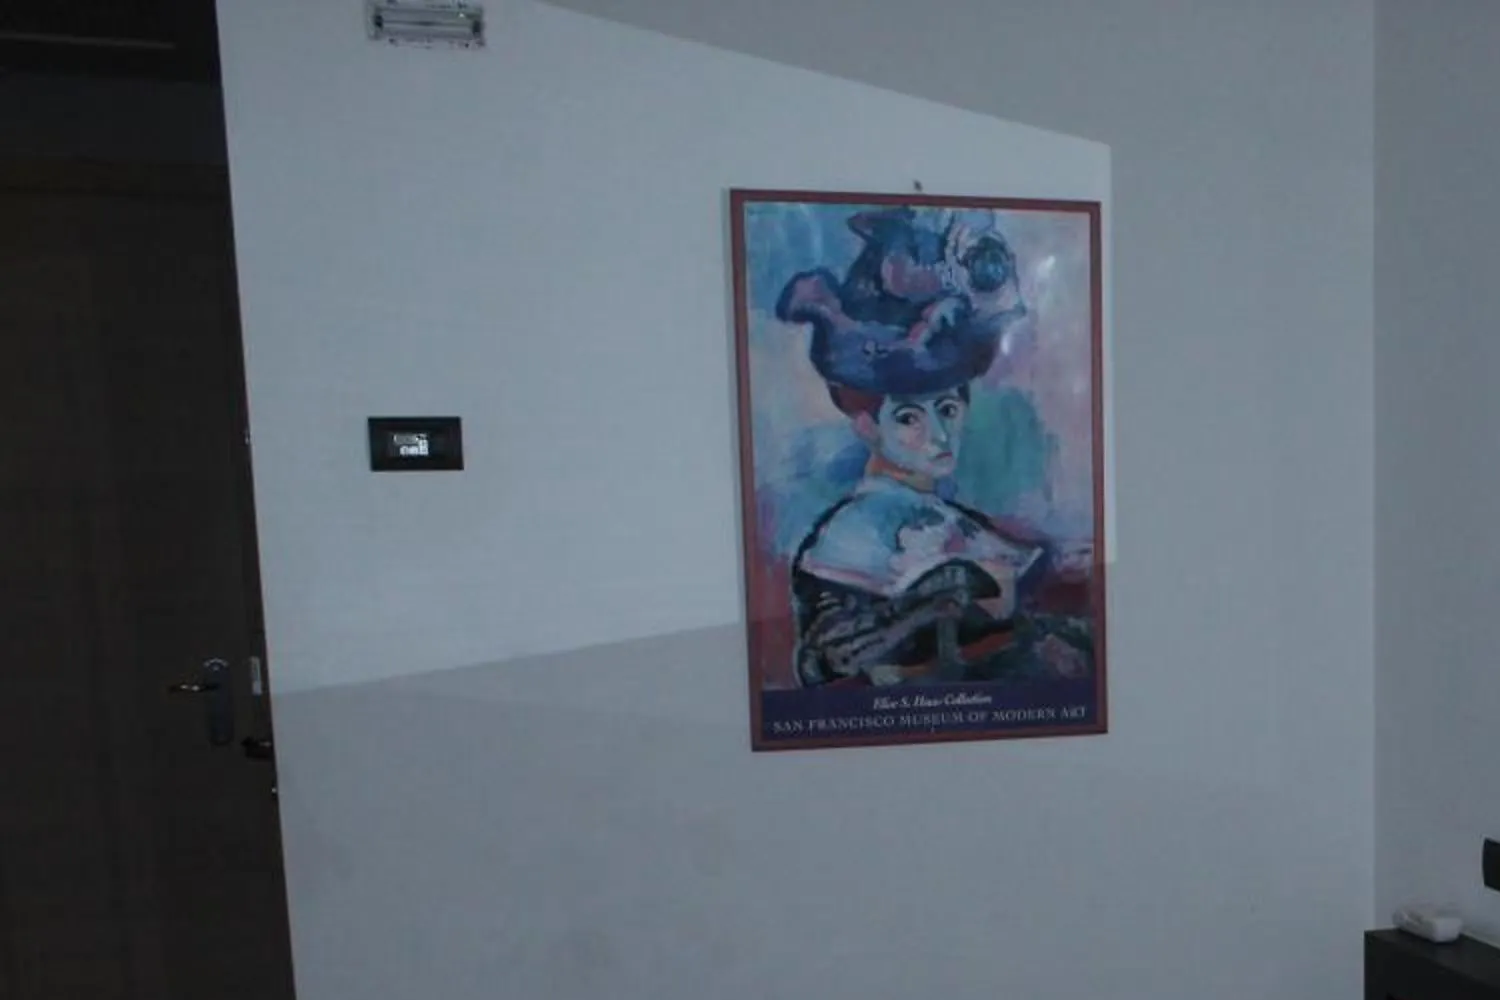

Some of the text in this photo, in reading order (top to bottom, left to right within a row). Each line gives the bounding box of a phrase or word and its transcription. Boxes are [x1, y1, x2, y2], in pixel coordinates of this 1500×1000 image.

[773, 706, 1086, 734] SAN FRANCISCO MUSEUM OF MODERN ART
